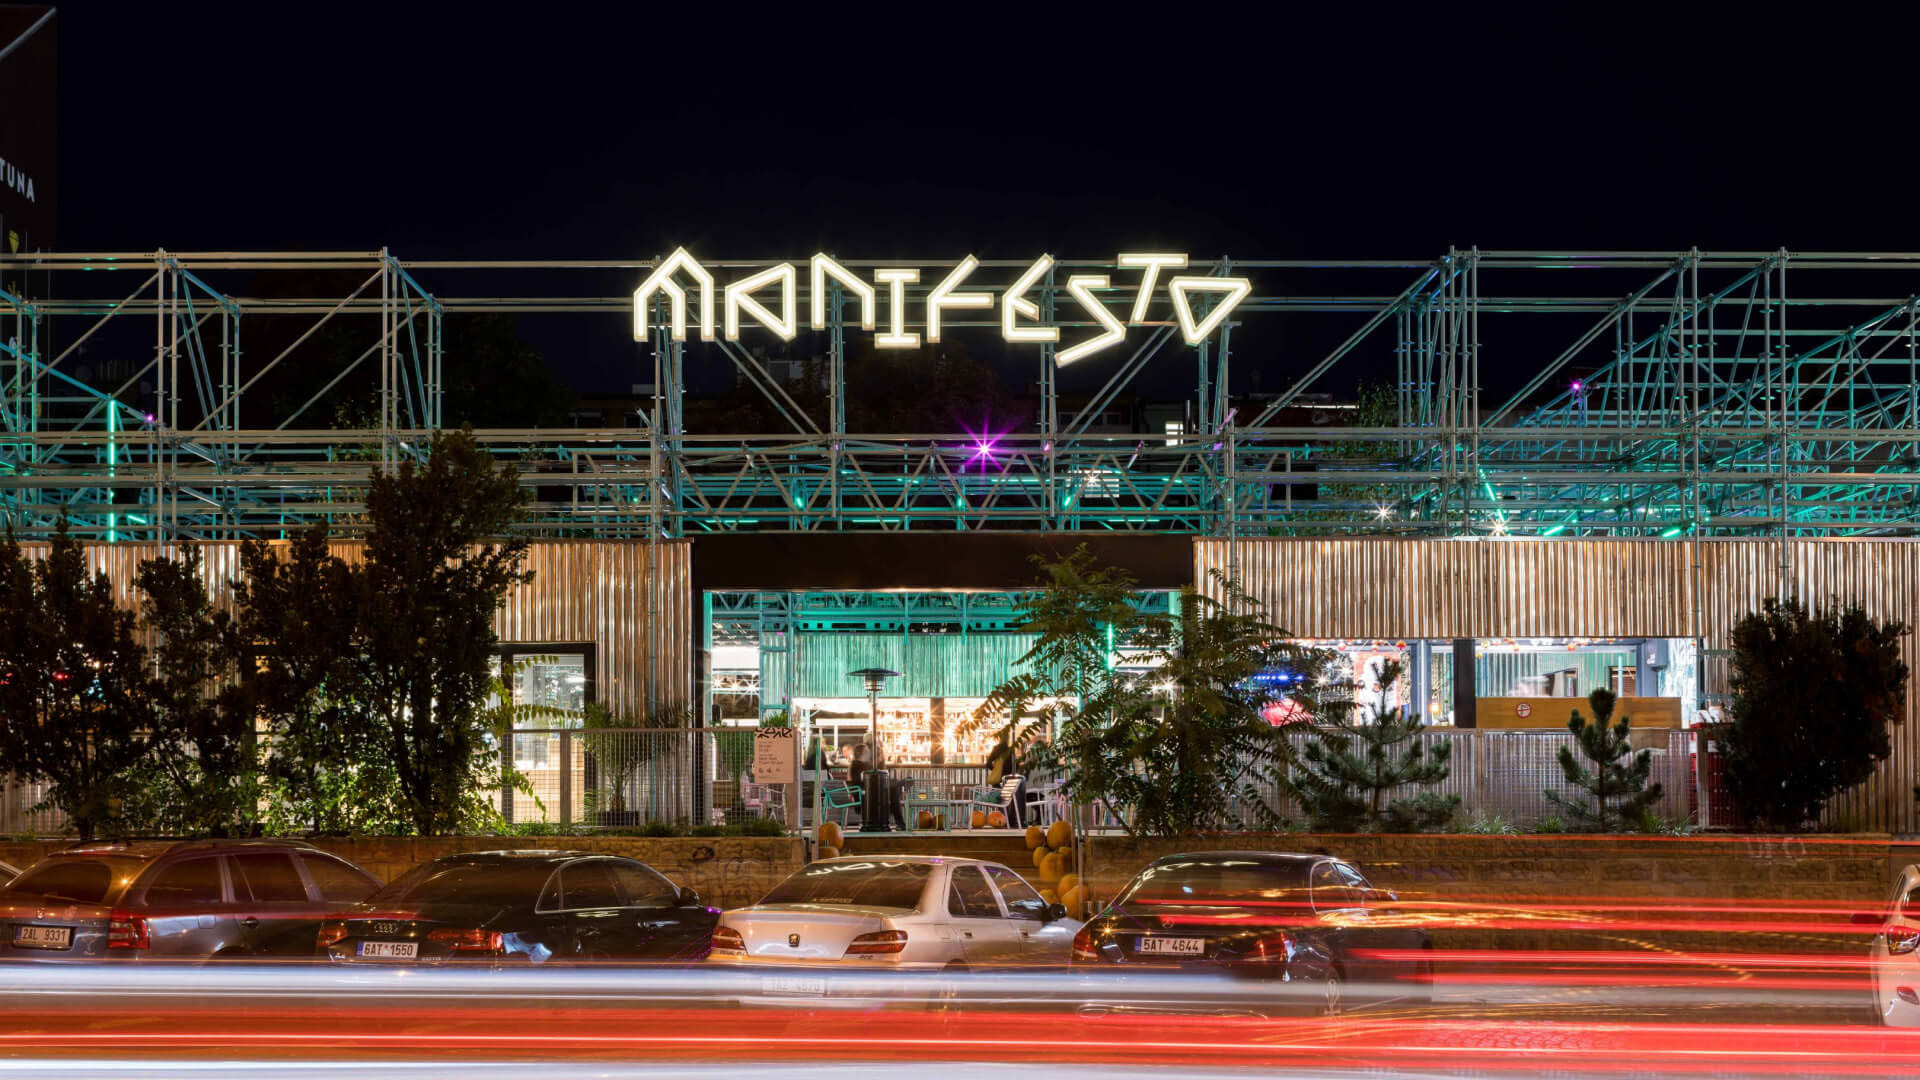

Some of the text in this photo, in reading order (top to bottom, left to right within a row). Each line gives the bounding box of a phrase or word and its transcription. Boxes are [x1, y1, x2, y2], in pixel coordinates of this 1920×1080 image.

[634, 246, 1252, 368] MANIFESTO
[22, 927, 66, 942] 2AL 9331
[364, 943, 413, 957] 6AT 1550
[1143, 938, 1199, 952] 5AT 4644
